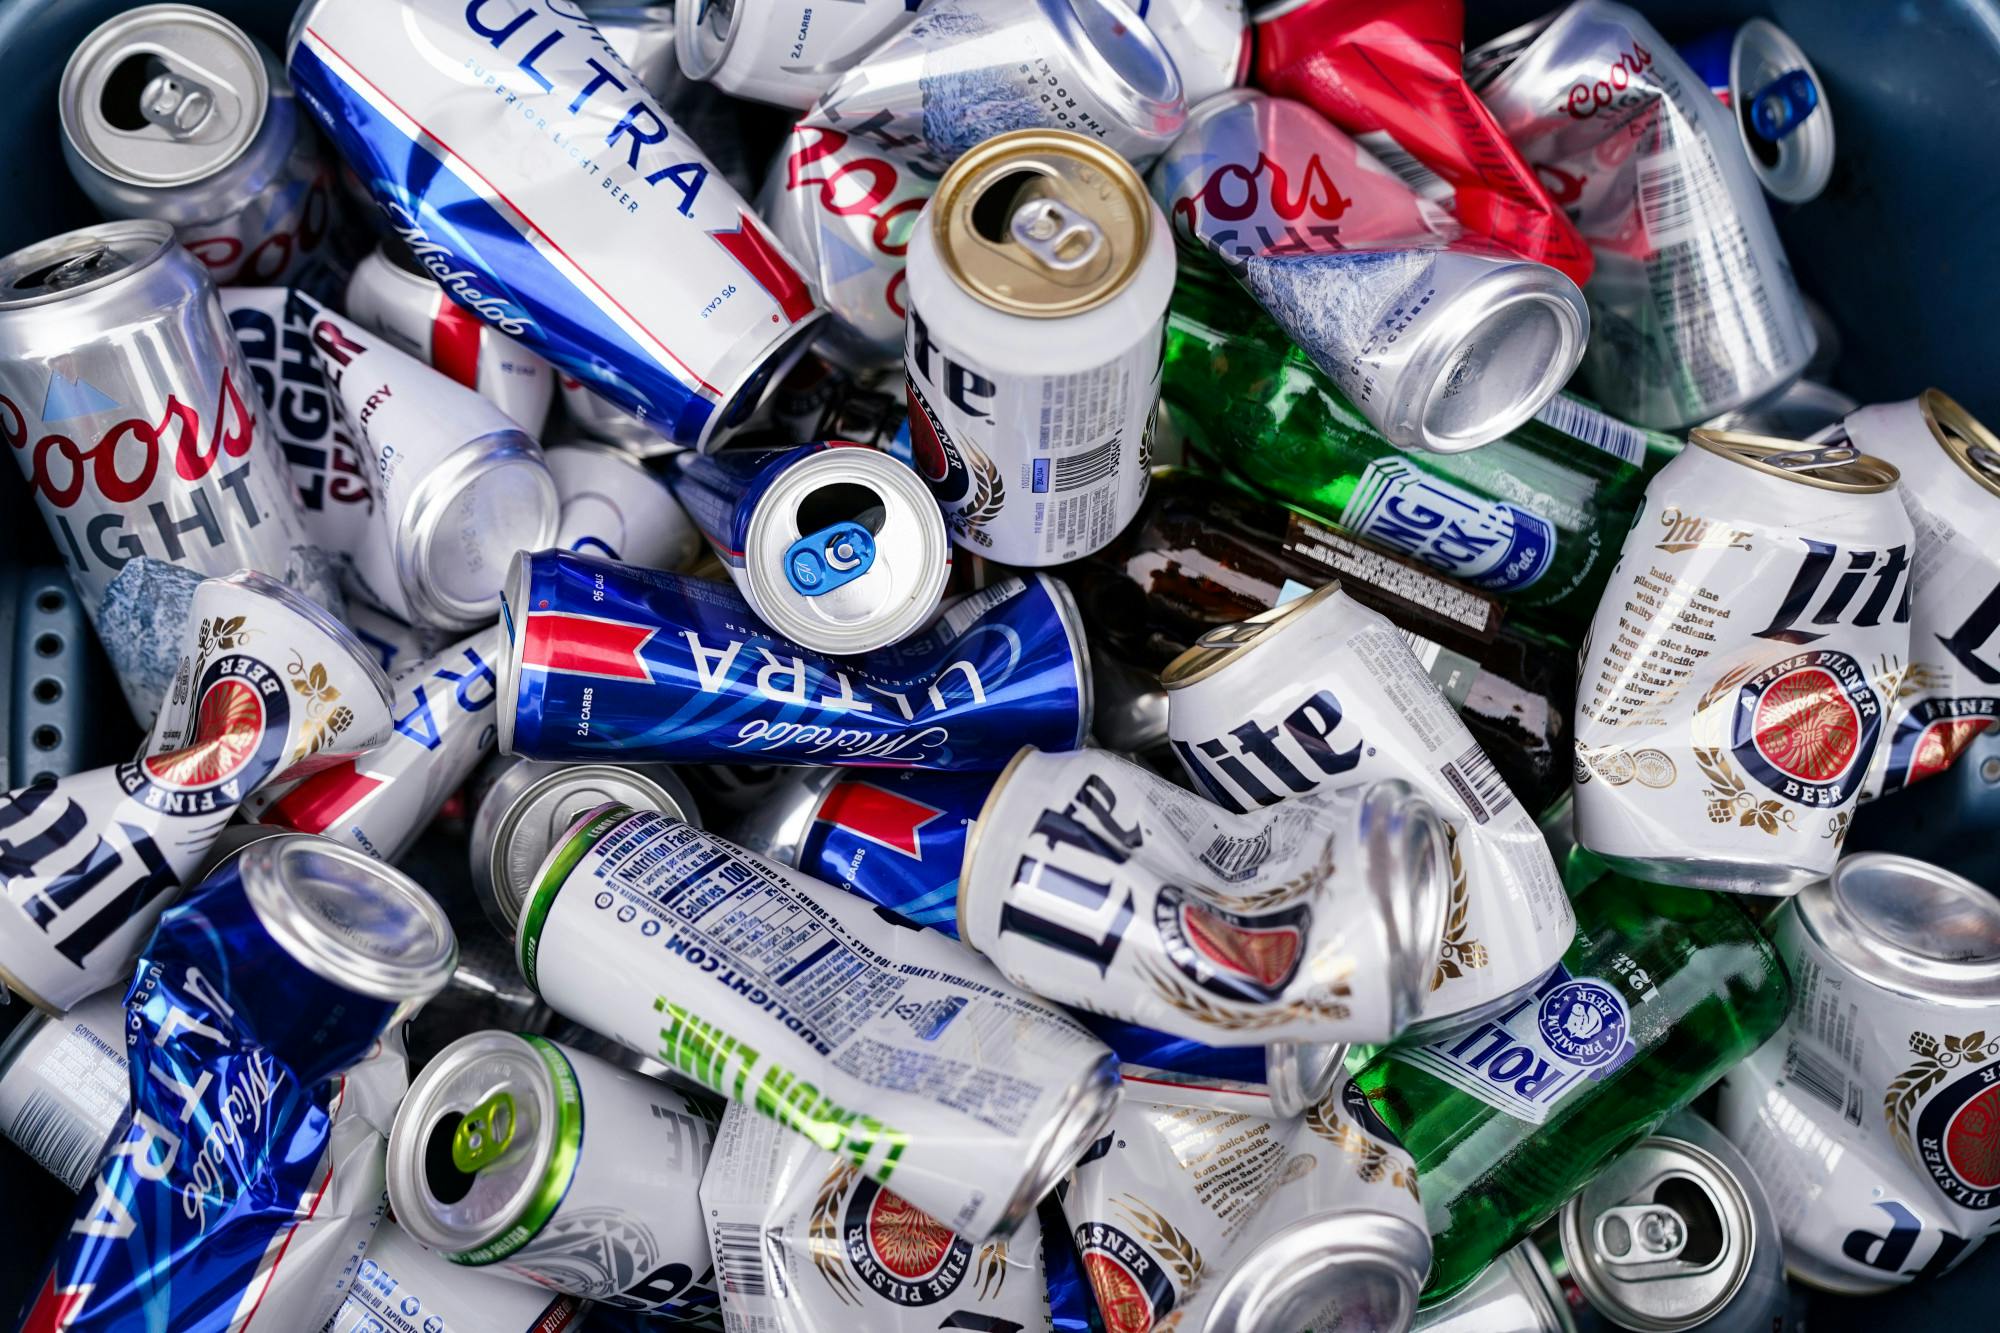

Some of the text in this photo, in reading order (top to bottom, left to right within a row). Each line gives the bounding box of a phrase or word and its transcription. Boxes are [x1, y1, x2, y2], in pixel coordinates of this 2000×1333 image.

[791, 8, 812, 60] 2.6 CARBS
[1019, 64, 1077, 129] COLD AS
[1558, 41, 1652, 119] Coors
[464, 0, 709, 216] ULTRA
[1079, 112, 1106, 138] THE
[464, 57, 639, 215] SUPERIOR LIGHT BEER
[387, 200, 528, 337] Michelob
[700, 284, 737, 319] 95 CALS
[1360, 376, 1375, 403] THE
[62, 462, 251, 574] IGHT
[1420, 519, 1500, 572] OCK
[1507, 546, 1538, 580] Pale
[593, 574, 604, 601] 95 CALS
[1633, 574, 1731, 619] pilsner brewed
[1636, 591, 1655, 606] with
[1650, 566, 1719, 602] Inside fine
[1753, 537, 1913, 645] Lit
[1625, 600, 1654, 622] quality
[725, 622, 772, 641] BEER
[1618, 616, 1631, 631] We
[1685, 644, 1709, 659] hops
[1618, 632, 1696, 668] from Pacific
[220, 655, 280, 699] BEER
[684, 630, 986, 720] ULTRA
[1601, 671, 1618, 685] and
[1642, 671, 1667, 687] Saaz
[1660, 665, 1671, 676] as
[1740, 653, 1877, 717] A FINE PILSNER
[577, 687, 593, 736] 2.6 CARBS
[728, 719, 948, 761] Michelob
[1172, 690, 1364, 815] Lite
[143, 780, 241, 816] A FINE
[1783, 780, 1844, 805] BEER
[595, 823, 637, 857] NATURALLY
[618, 828, 699, 883] Nutrition Facts
[642, 863, 671, 887] serving
[667, 852, 680, 869] per
[677, 841, 704, 862] container
[749, 859, 778, 882] CARBS
[847, 848, 865, 881] CARBS
[999, 772, 1144, 980] Lite
[675, 861, 752, 920] Calories 100
[796, 892, 829, 919] SUGARS
[851, 939, 891, 968] 100 CALS
[898, 964, 938, 980] FLAVORS
[664, 932, 832, 1057] BUDLIGHT.COM
[939, 972, 991, 993] ARTIFICIAL
[1628, 968, 1661, 1007] 12
[1576, 990, 1613, 1017] BEER
[75, 1023, 119, 1062] GOVERNMENT
[1547, 1014, 1604, 1056] PREMIUM
[183, 1048, 286, 1236] Michelob
[1245, 1122, 1271, 1140] hops
[1218, 1153, 1236, 1167] the
[1236, 1136, 1269, 1158] Pacific
[1194, 1161, 1246, 1195] Northwest
[1247, 1154, 1258, 1166] as
[1200, 1194, 1212, 1205] as
[1212, 1177, 1240, 1196] noble
[1211, 1172, 1263, 1211] and deliver
[1922, 1137, 1991, 1208] PILSNER
[1217, 1198, 1245, 1219] taste,
[848, 1224, 968, 1303] FINE PILSNER
